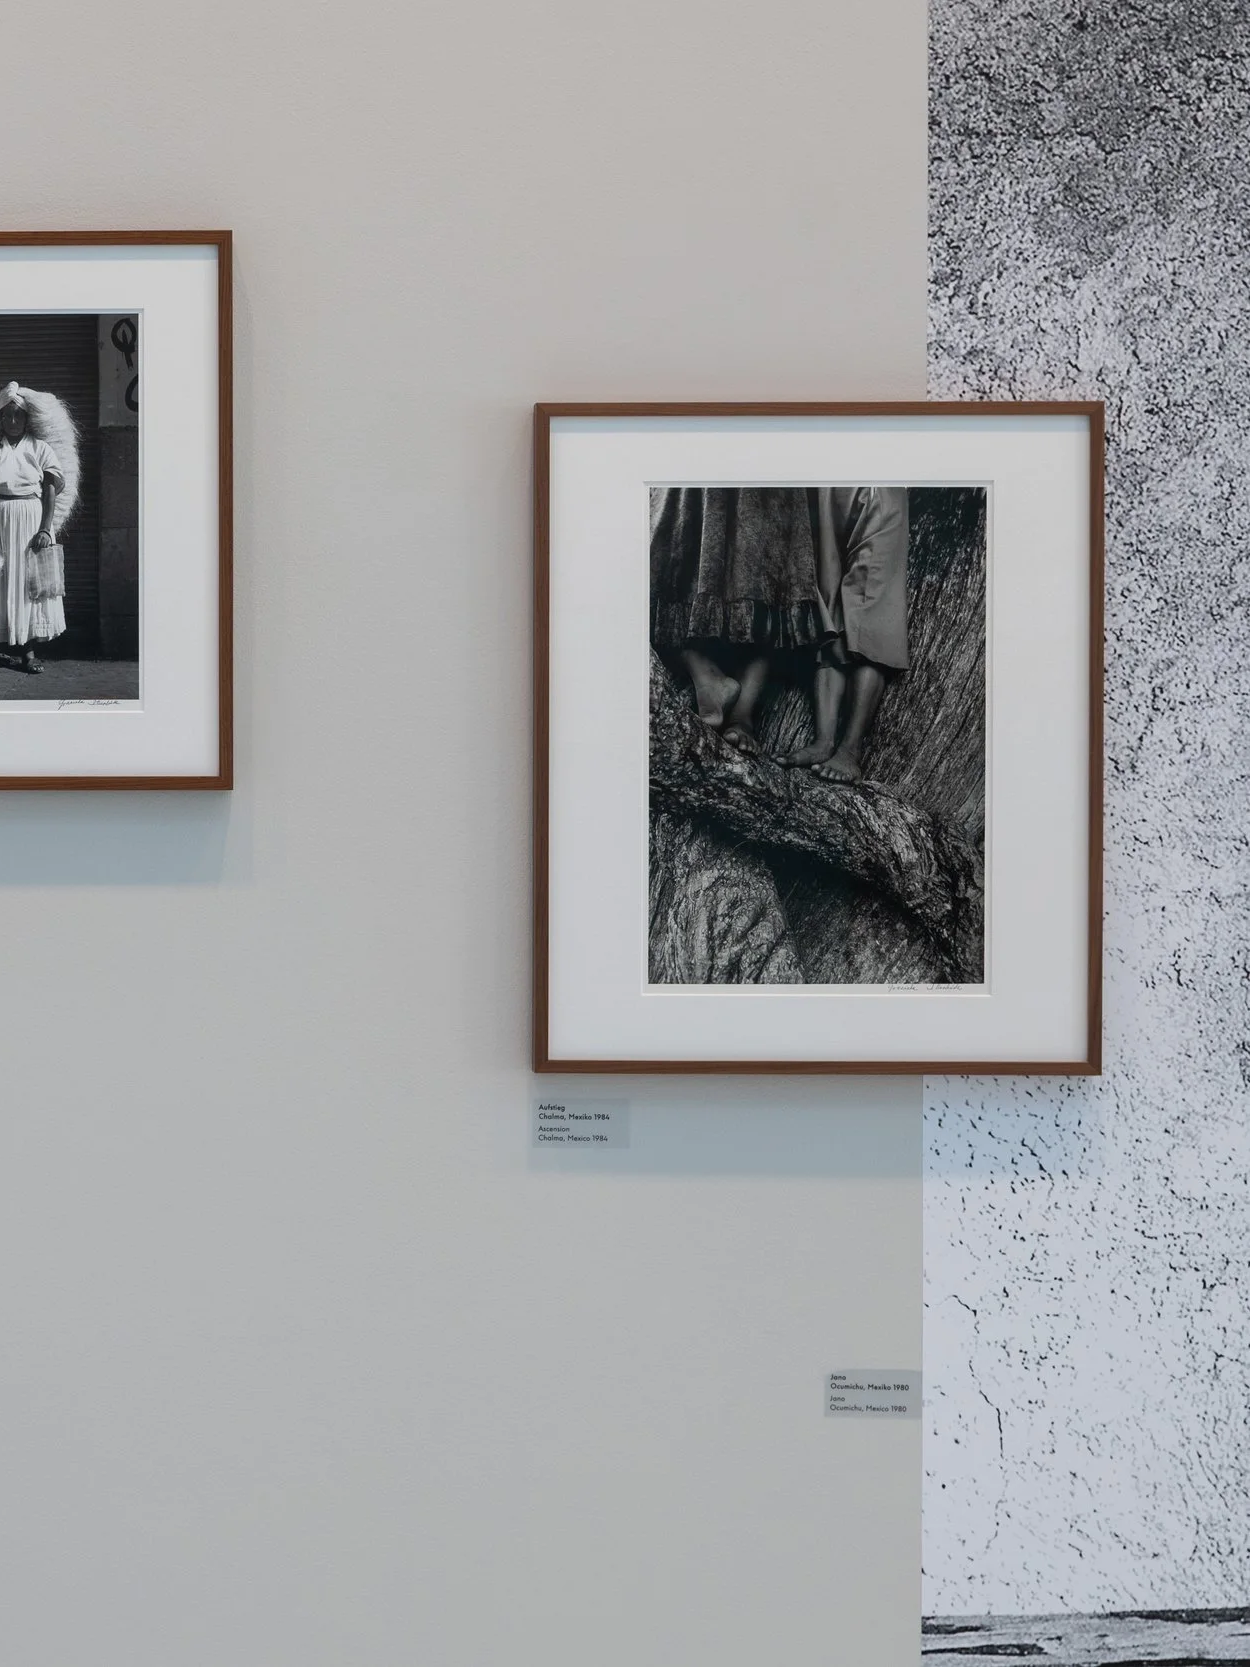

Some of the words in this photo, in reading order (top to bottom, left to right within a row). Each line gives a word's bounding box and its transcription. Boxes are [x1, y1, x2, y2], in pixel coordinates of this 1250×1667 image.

[538, 1104, 565, 1112] Aufstieg
[538, 1113, 566, 1121] Chalma,
[538, 1134, 565, 1142] Chalma,
